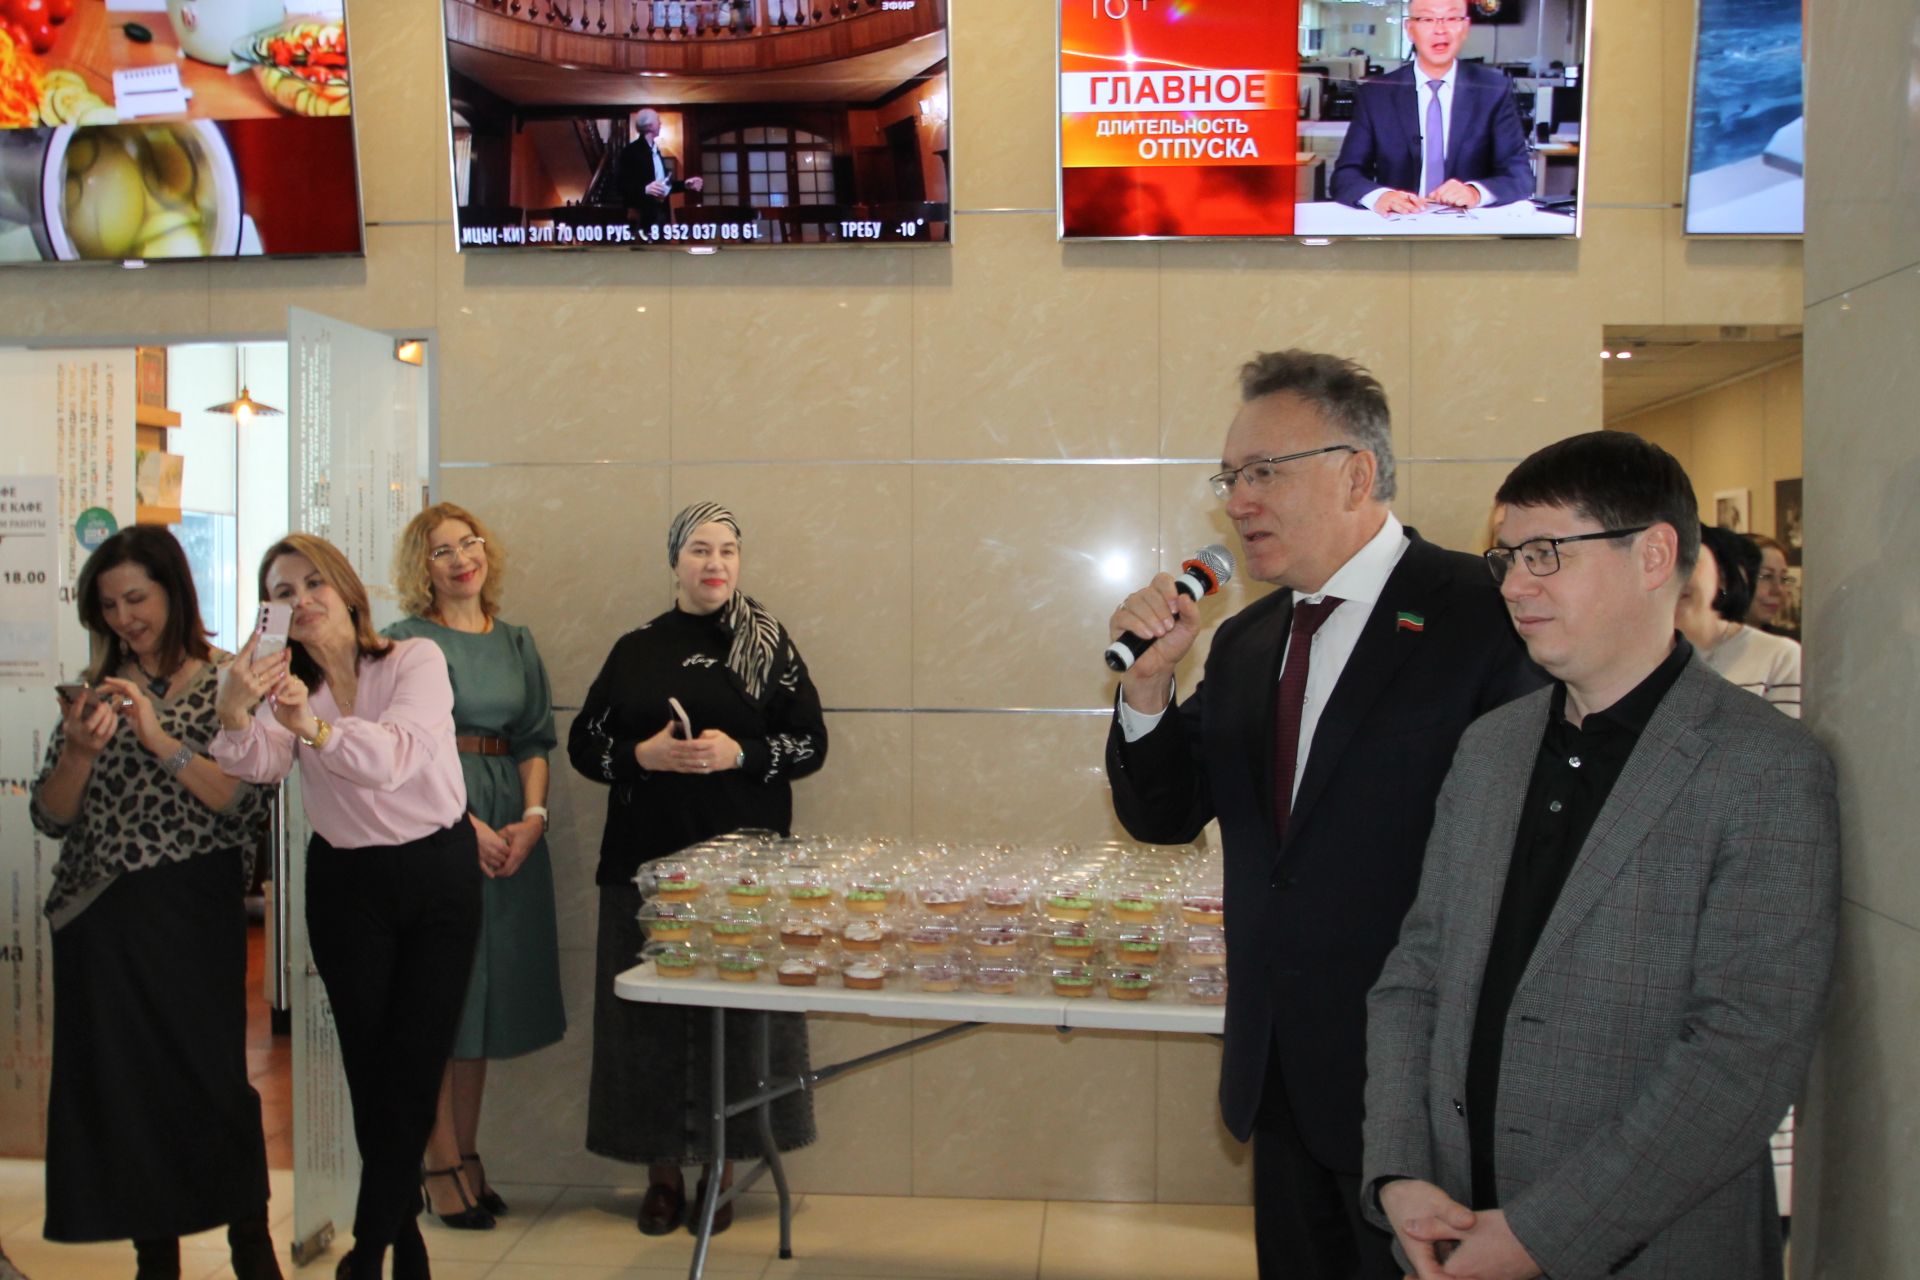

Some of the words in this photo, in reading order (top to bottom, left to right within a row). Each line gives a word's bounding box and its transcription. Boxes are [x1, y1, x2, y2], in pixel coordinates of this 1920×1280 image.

[1090, 75, 1266, 105] ГЛАВНОЕ
[1096, 118, 1249, 137] ДЛИТЕЛЬНОСТЬ
[1138, 137, 1259, 159] ОТПУСКА
[529, 227, 552, 242] З/П
[557, 224, 573, 242] 70
[576, 225, 603, 242] 000
[606, 224, 635, 242] РУБ.
[650, 223, 660, 240] 8
[663, 223, 689, 240] 952
[692, 223, 717, 240] 037
[721, 223, 739, 239] 08
[840, 221, 882, 238] ТРЕБУ
[896, 218, 924, 236] -10°
[11, 502, 43, 513] КАФЕ
[10, 519, 46, 528] РАБОТЫ
[5, 571, 46, 584] 18.00
